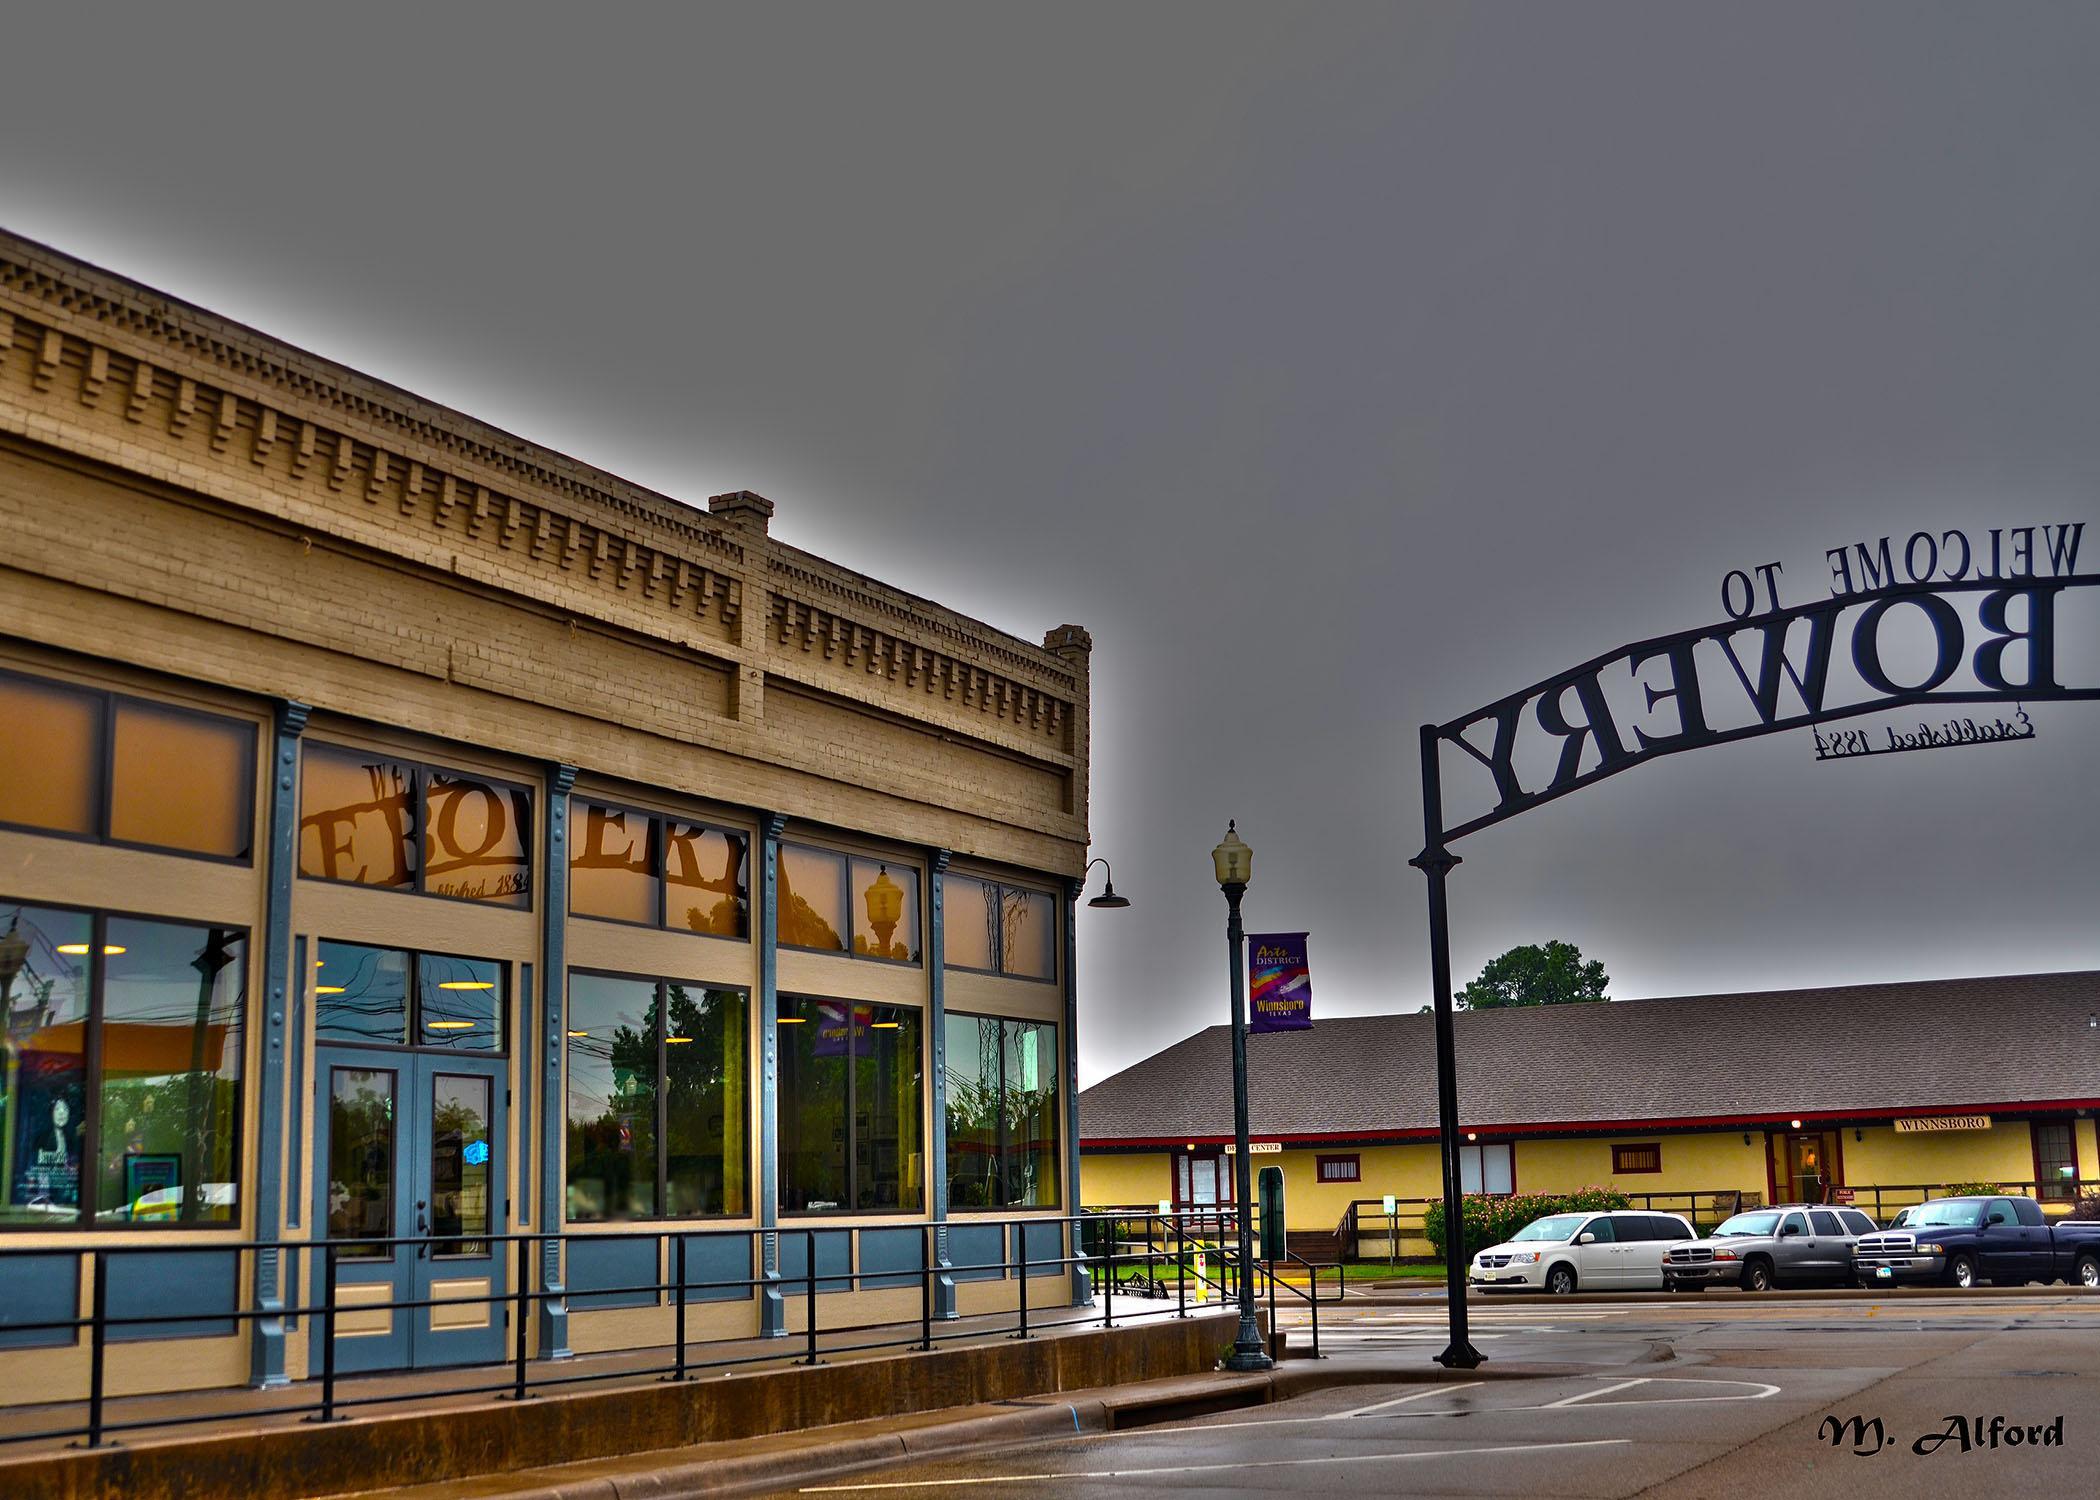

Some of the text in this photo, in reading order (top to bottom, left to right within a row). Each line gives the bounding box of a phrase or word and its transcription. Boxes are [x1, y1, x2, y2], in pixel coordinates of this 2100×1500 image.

[1256, 944, 1288, 958] Arts
[1256, 956, 1301, 966] DISTRICT
[1256, 999, 1305, 1013] Winnsboro
[1900, 1117, 1986, 1131] WINNSBORO
[1251, 1143, 1280, 1152] CENTER
